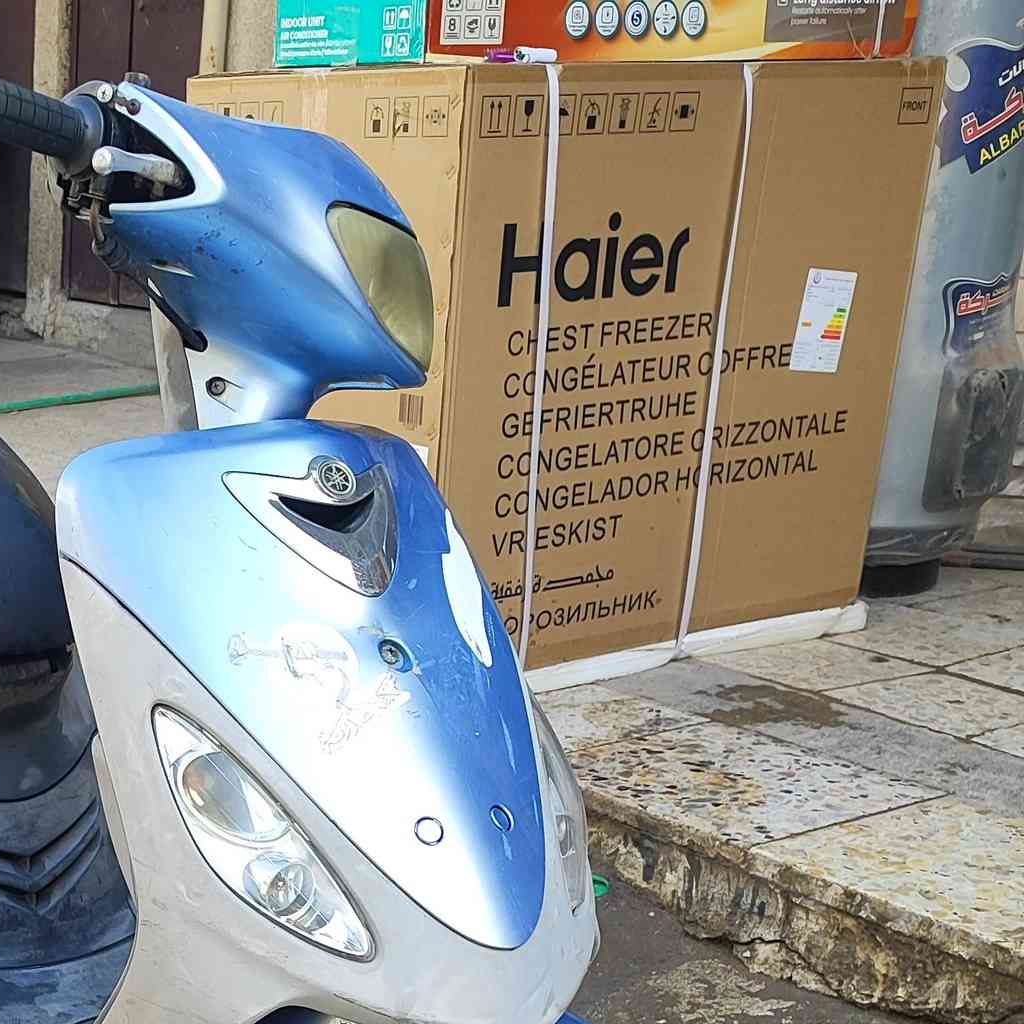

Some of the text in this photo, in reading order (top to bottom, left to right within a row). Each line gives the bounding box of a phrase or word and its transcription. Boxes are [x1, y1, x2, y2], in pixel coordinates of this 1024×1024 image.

[281, 15, 325, 28] INDOOR UNIT
[902, 101, 927, 111] FRONT
[497, 211, 690, 307] Haier
[508, 312, 712, 356] CHEST FREEZER
[504, 353, 690, 399] CONGÉLATEUR
[698, 343, 792, 376] COFFRE
[501, 391, 696, 438] GEFRIERTRUHE
[497, 410, 848, 479] CONGELATORE ORIZZONTALE
[495, 449, 818, 518] CONGELADOR HORIZONTAL
[492, 514, 623, 557] VRESKIST
[491, 578, 525, 604] فقية
